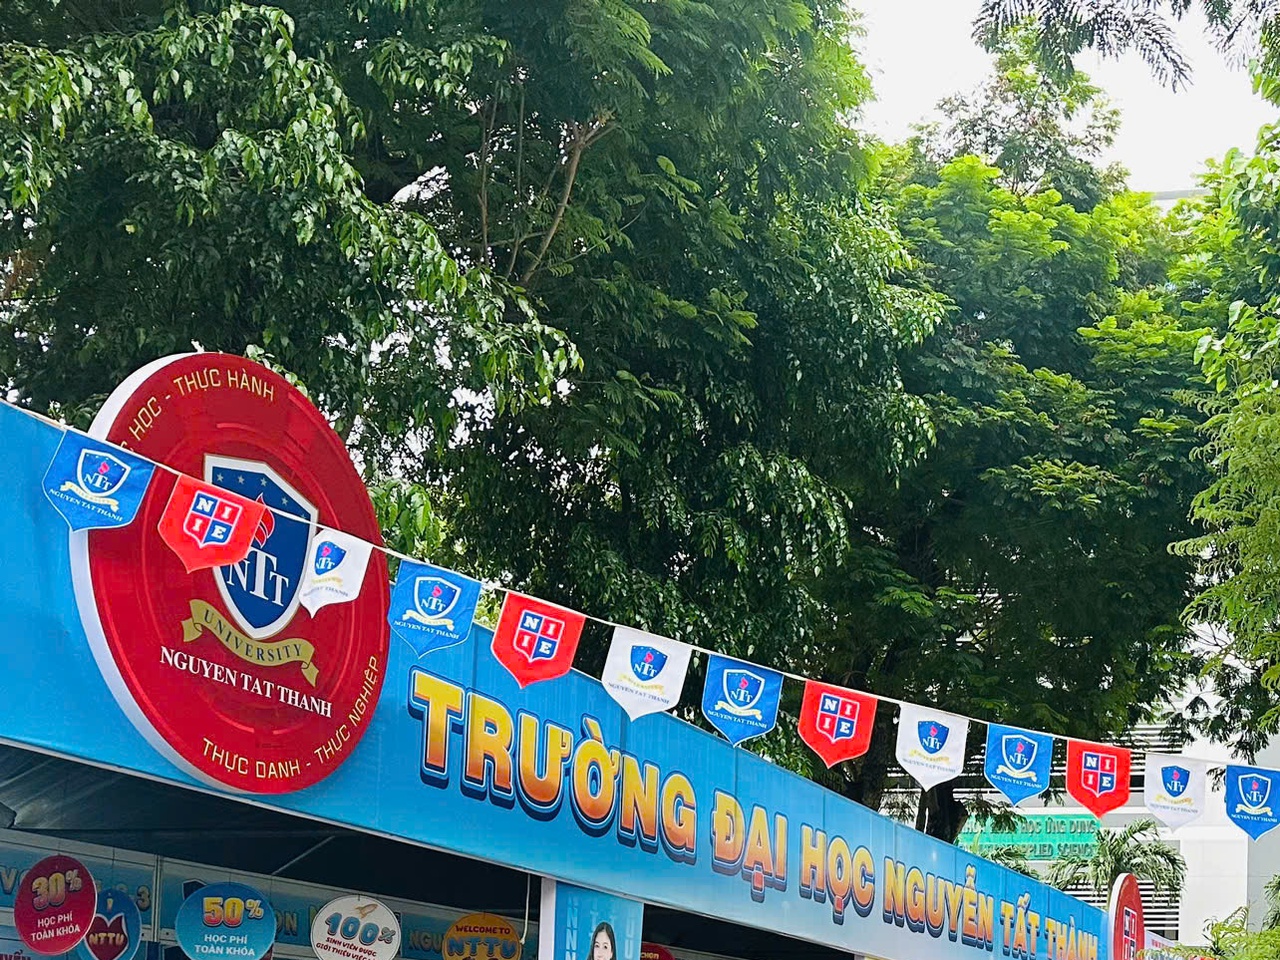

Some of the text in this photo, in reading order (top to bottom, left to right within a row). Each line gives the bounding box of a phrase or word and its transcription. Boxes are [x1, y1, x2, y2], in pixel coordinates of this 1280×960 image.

[129, 367, 275, 441] HỌC THỰC HÀNH
[83, 472, 113, 491] NTT
[48, 487, 81, 506] NGUYEN
[97, 506, 123, 522] THANH
[227, 545, 290, 607] NTT
[420, 596, 446, 613] NTT
[203, 608, 302, 662] UNIVERSITY
[393, 620, 421, 632] NGUYEN
[434, 628, 460, 640] THANH
[633, 661, 658, 678] NTT
[159, 645, 333, 719] NGUYEN TAT THANH
[730, 688, 753, 703] NTT
[202, 654, 380, 779] THỰC DANH THỰC NGHIỆP
[411, 668, 697, 856] TRƯỜNG
[711, 789, 789, 898] ĐẠI
[800, 823, 876, 922] HỌC
[882, 856, 994, 950] NGUYỄN
[1000, 893, 1040, 960] TẤT
[32, 869, 82, 911] 30%
[37, 911, 73, 928] HỌC PHÍ
[203, 896, 264, 928] 50%
[31, 924, 80, 941] TOÀN KHÓA
[88, 932, 124, 945] NTTU
[204, 933, 248, 944] HỌC PHÍ
[325, 912, 396, 946] 100%
[455, 924, 511, 935] WELCOME TO
[194, 944, 255, 956] TOÀN KHÓA
[325, 936, 342, 946] SINH
[447, 937, 517, 959] NTTU
